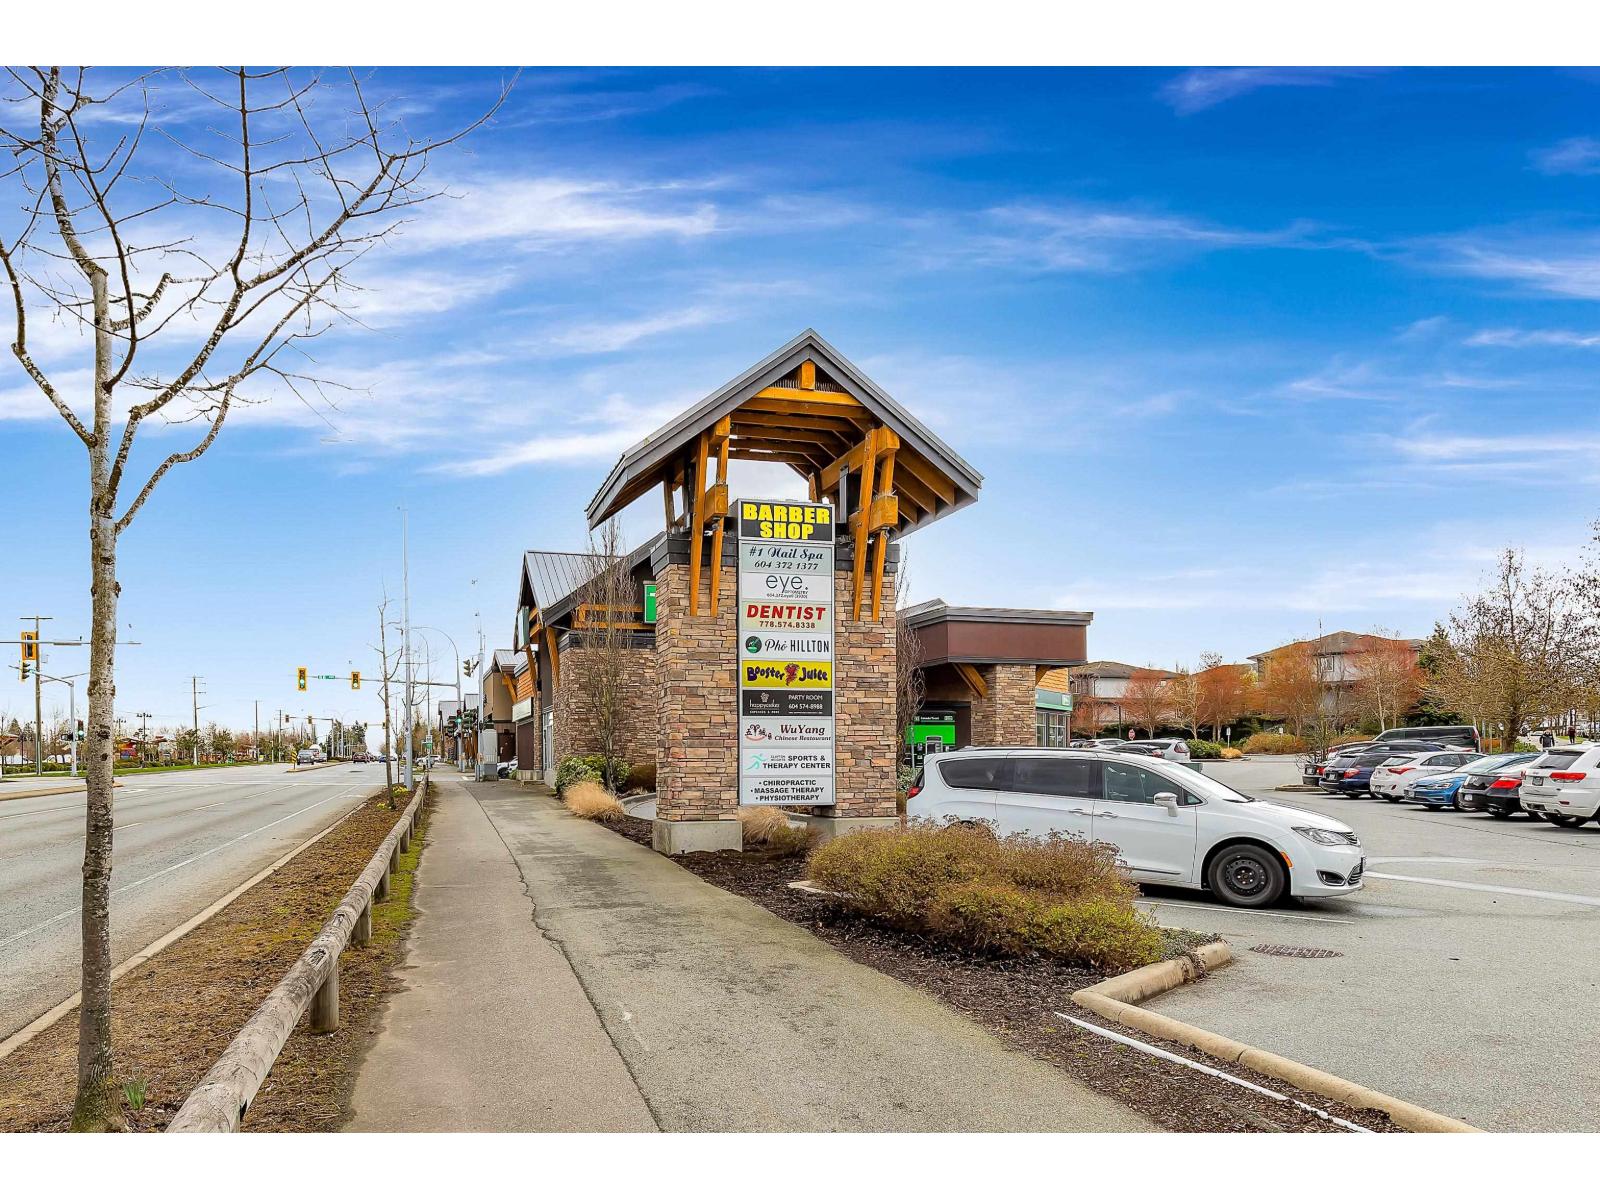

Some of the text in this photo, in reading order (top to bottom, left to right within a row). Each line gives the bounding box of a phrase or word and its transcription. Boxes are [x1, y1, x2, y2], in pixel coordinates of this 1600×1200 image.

[742, 503, 830, 524] BARBER
[760, 522, 814, 540] SHOP
[749, 546, 824, 561] #1 Nail Spa
[796, 562, 818, 570] 1377
[747, 604, 826, 620] DENTIST
[790, 639, 829, 652] HILLTON
[747, 665, 828, 682] Booster Juice
[780, 724, 825, 735] WuYang
